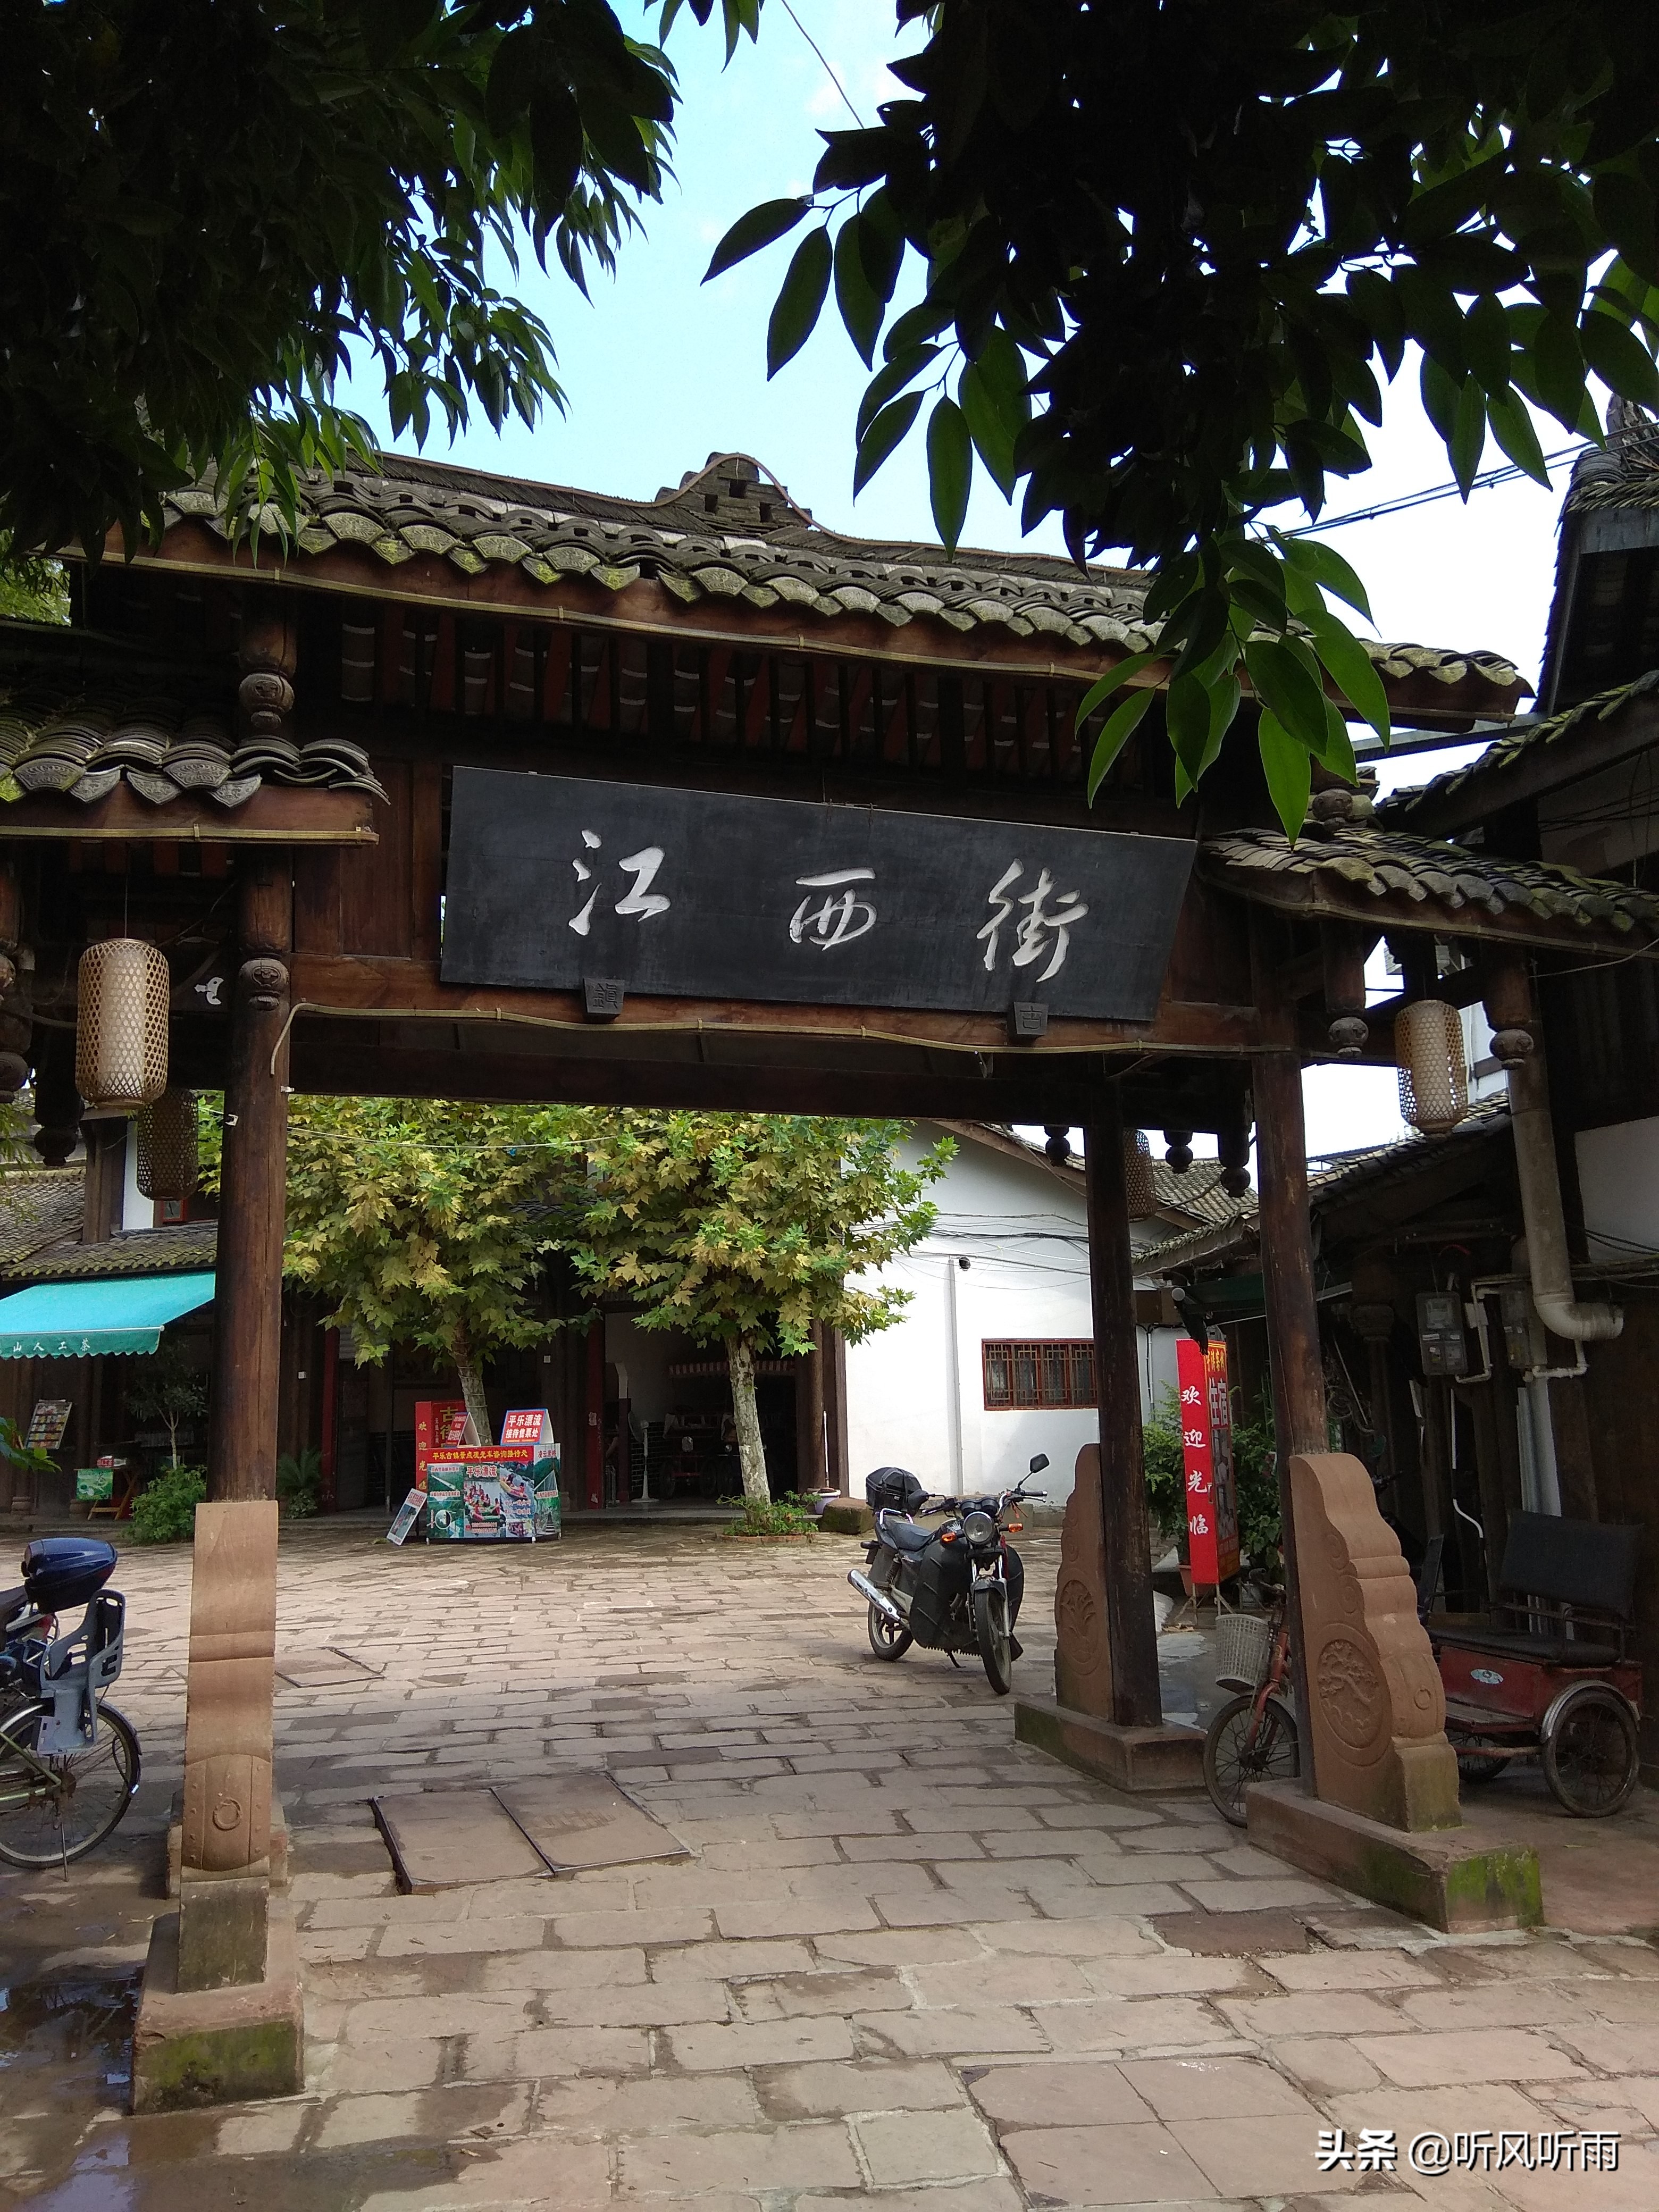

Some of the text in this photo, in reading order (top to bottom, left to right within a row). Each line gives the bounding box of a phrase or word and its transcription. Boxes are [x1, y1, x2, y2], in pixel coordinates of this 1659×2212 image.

[568, 828, 1089, 983] 江西街
[1209, 1377, 1228, 1427] 住宿
[505, 1428, 539, 1439] 接待售票处
[508, 1414, 542, 1427] 平乐漂流
[466, 1465, 498, 1478] 平乐漂流
[1180, 1386, 1208, 1536] 欢迎光临
